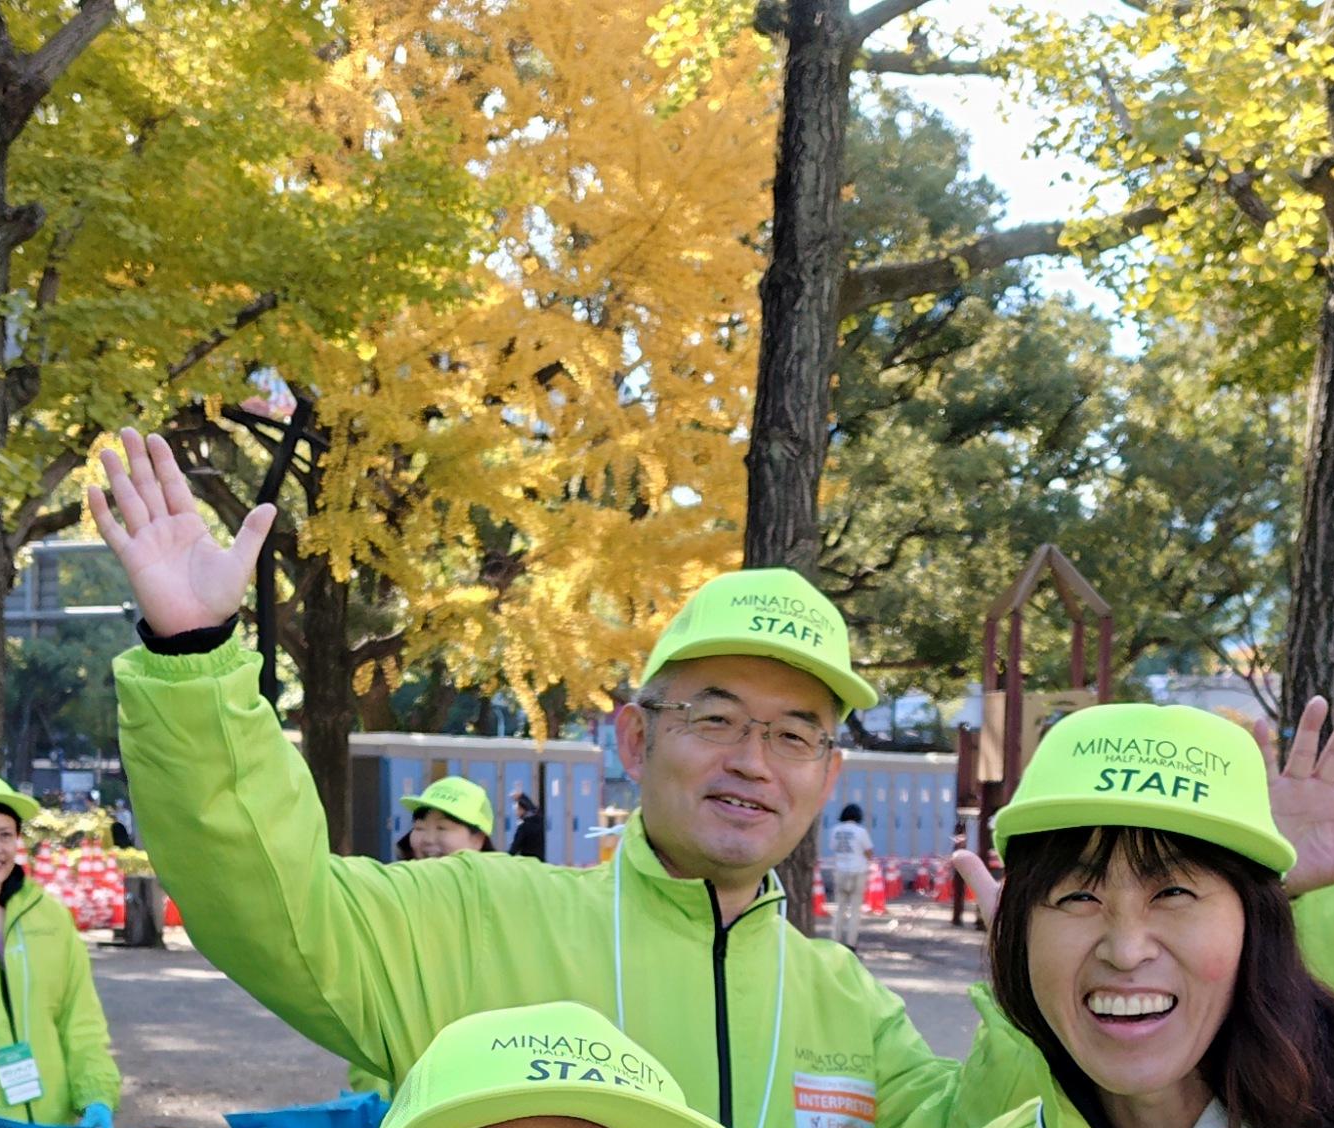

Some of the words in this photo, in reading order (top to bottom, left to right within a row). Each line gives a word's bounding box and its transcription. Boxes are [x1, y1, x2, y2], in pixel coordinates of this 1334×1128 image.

[731, 594, 805, 614] MINATO
[748, 615, 824, 648] STAFF
[1072, 737, 1177, 759] MINATO
[1185, 746, 1231, 777] CITY
[1105, 753, 1135, 763] HALF
[1138, 756, 1207, 778] MARATHON
[1093, 767, 1210, 804] STAFF
[490, 1034, 612, 1062] MINATO
[620, 1053, 665, 1093] CITY
